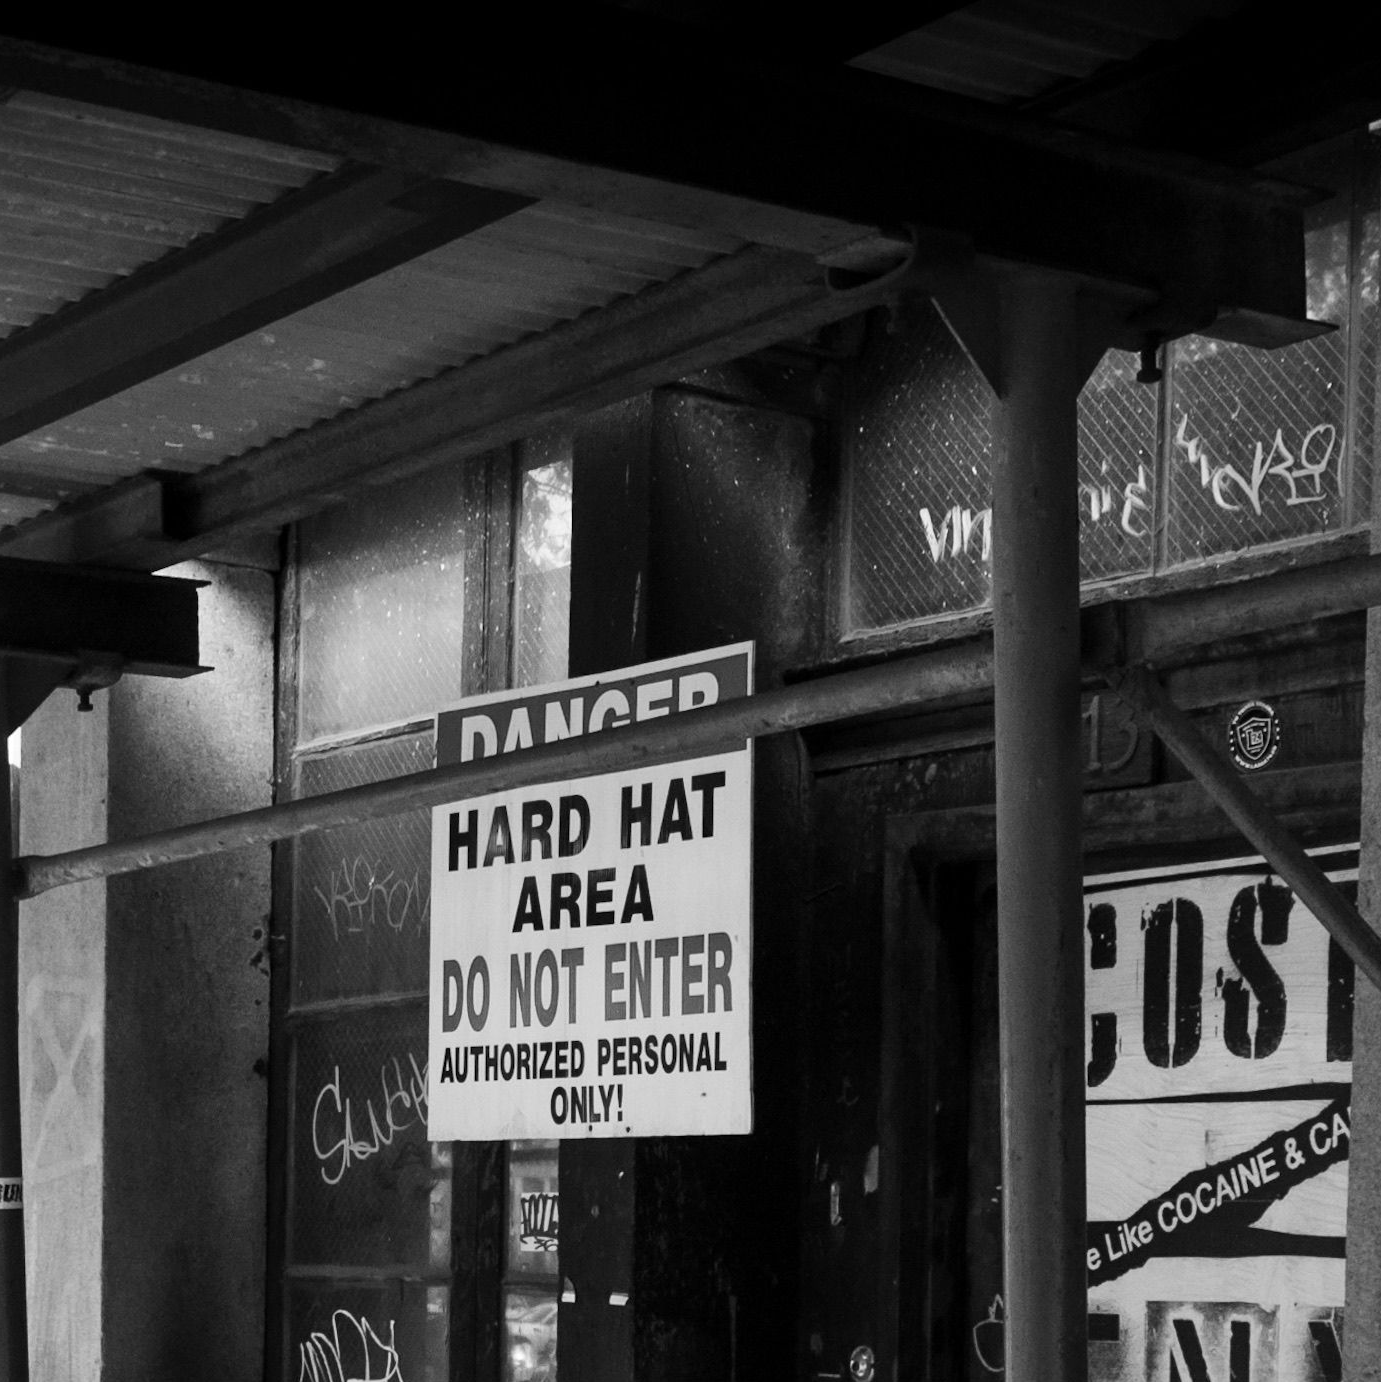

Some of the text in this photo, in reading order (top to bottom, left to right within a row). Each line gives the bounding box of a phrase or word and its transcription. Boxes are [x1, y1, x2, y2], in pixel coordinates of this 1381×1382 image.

[460, 671, 720, 763] DANGER
[448, 771, 726, 872] HARD HAT
[512, 864, 655, 933] AREA
[442, 932, 733, 1033] DO NOT ENTER
[440, 1032, 728, 1084] AUTHORIZED PERSONAL
[550, 1084, 624, 1125] ONLY!
[1104, 1220, 1155, 1263] Like
[1156, 1148, 1281, 1234] COCAINE
[1284, 1137, 1306, 1170] &
[1308, 1104, 1351, 1156] CA
